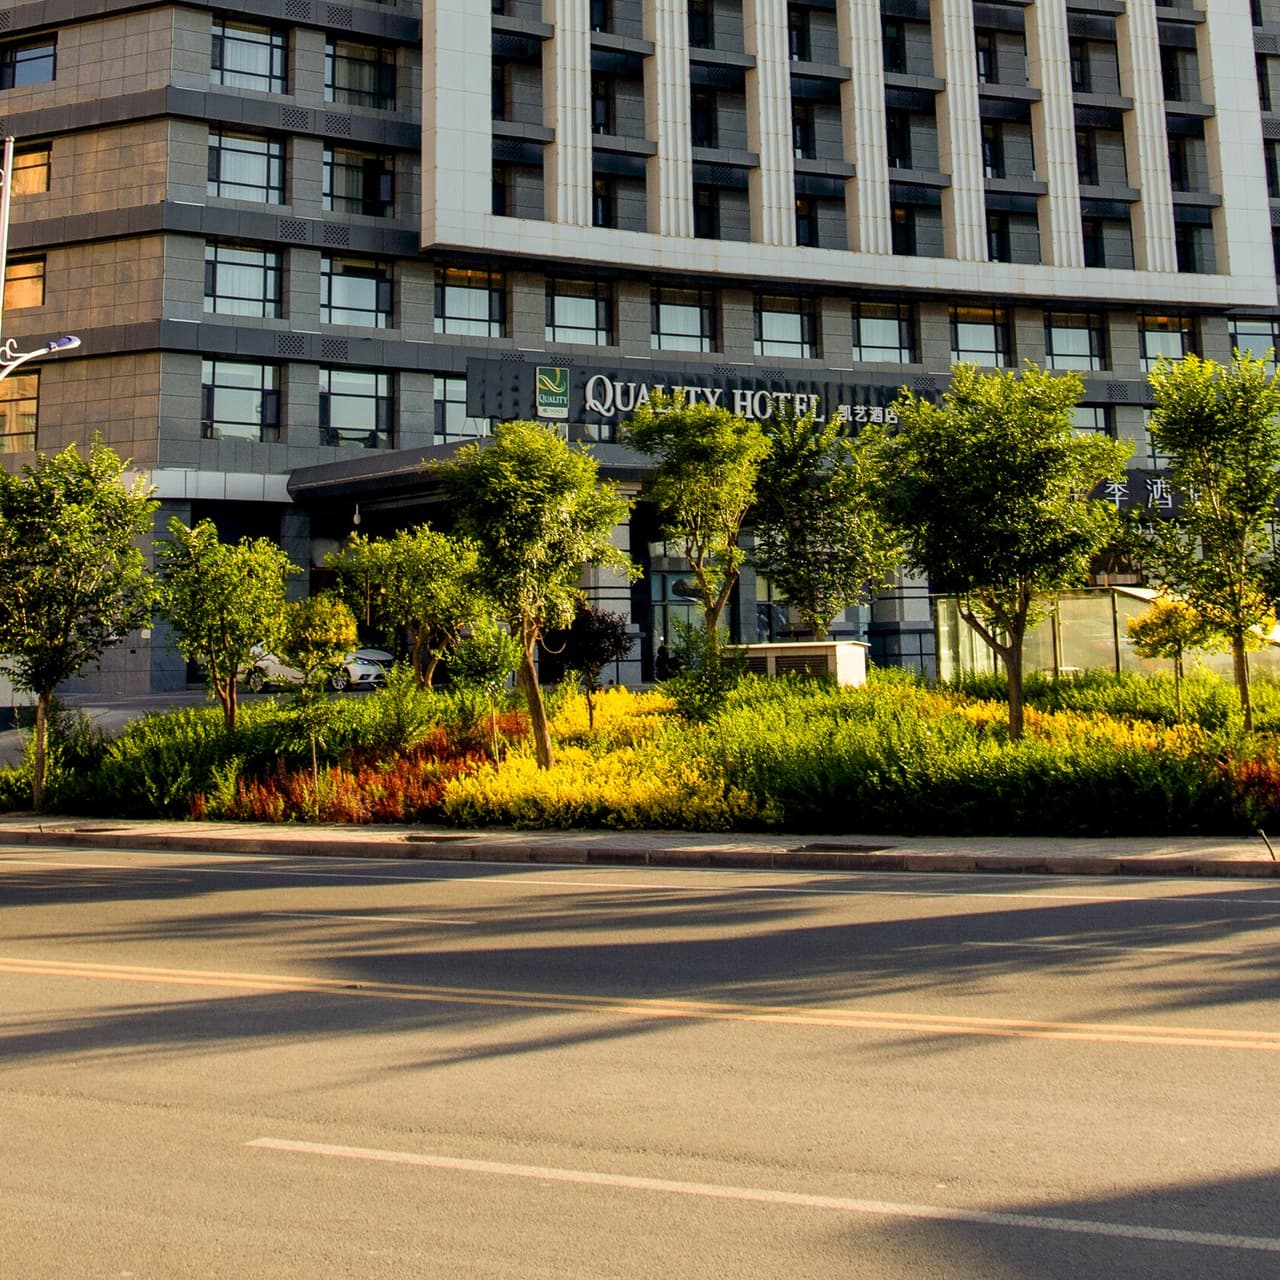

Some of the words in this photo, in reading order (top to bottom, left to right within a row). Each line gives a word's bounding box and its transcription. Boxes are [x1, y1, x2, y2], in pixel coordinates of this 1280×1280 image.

[539, 394, 569, 404] QUALITY
[732, 389, 825, 423] HOTEL
[837, 404, 898, 424] 凯艺酒店
